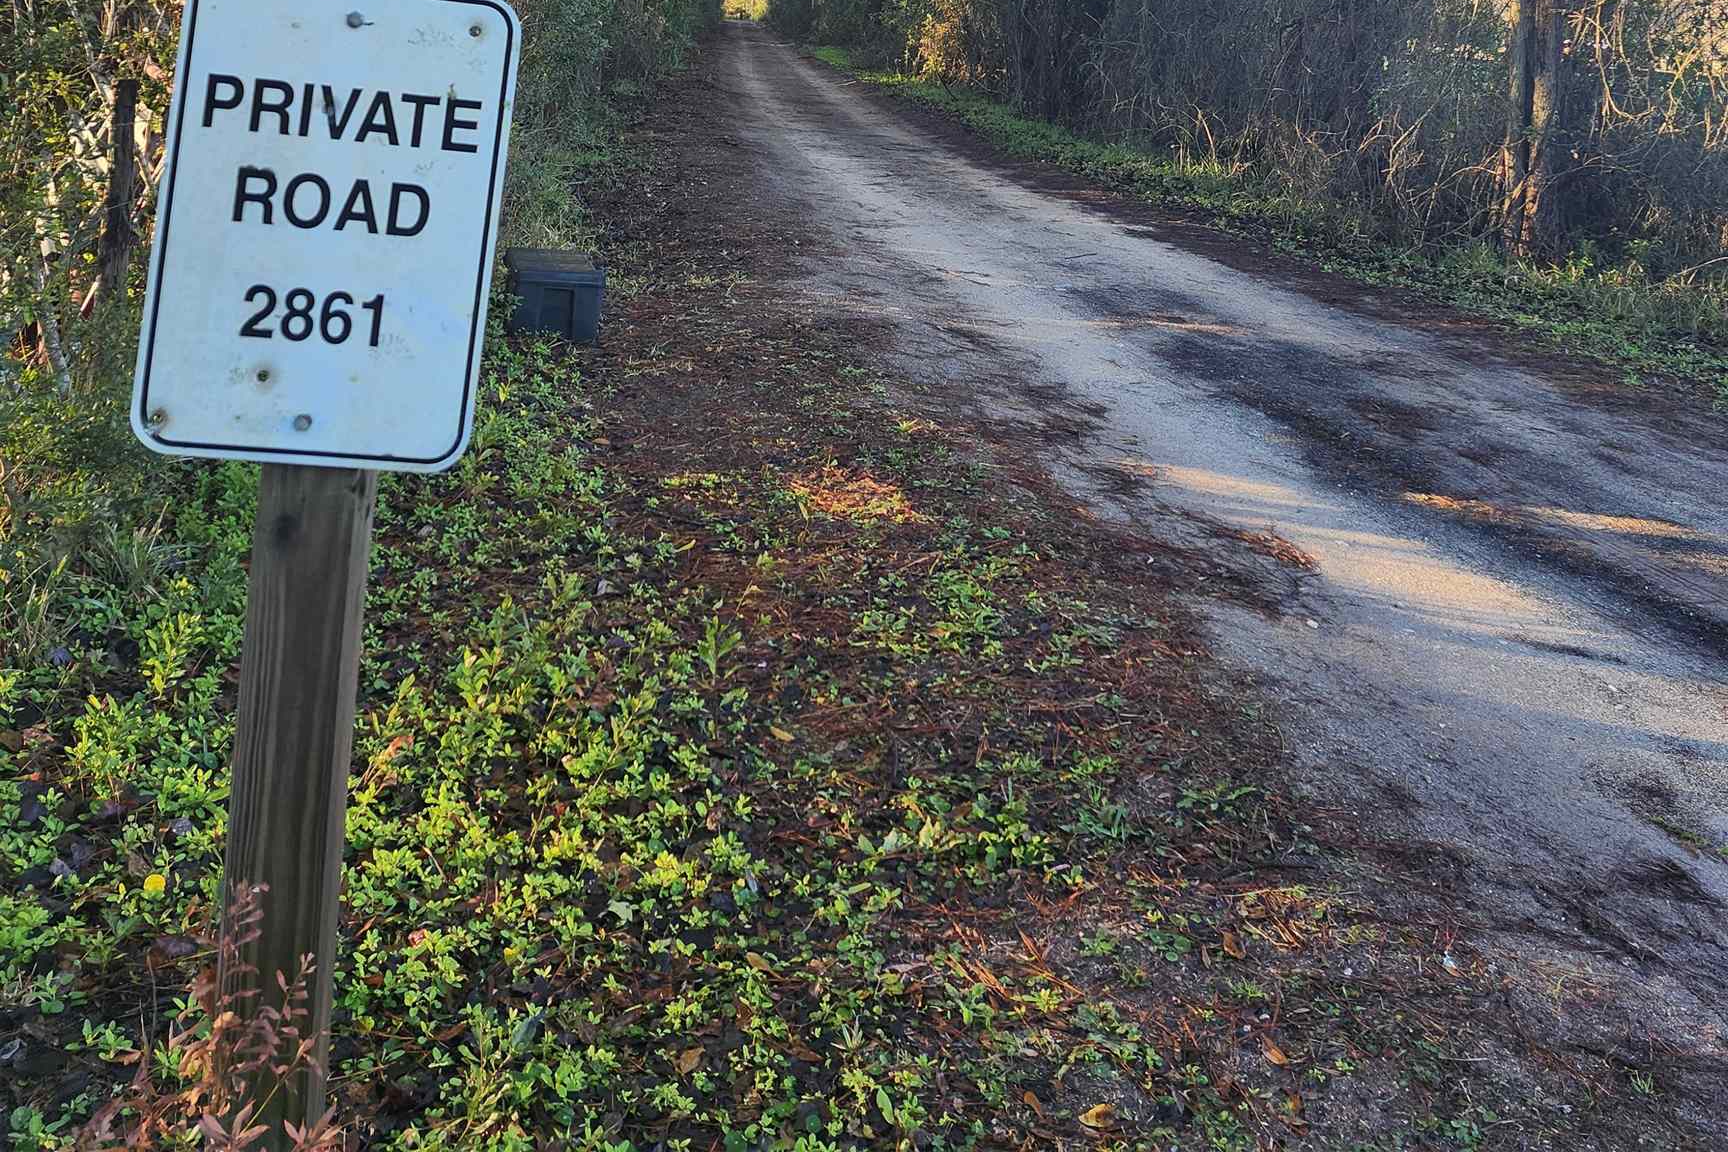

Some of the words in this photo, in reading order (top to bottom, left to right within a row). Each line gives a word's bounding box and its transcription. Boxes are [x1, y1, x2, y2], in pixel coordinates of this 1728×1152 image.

[201, 73, 483, 153] PRIVATE
[231, 166, 431, 237] ROAD
[238, 284, 386, 348] 2861
